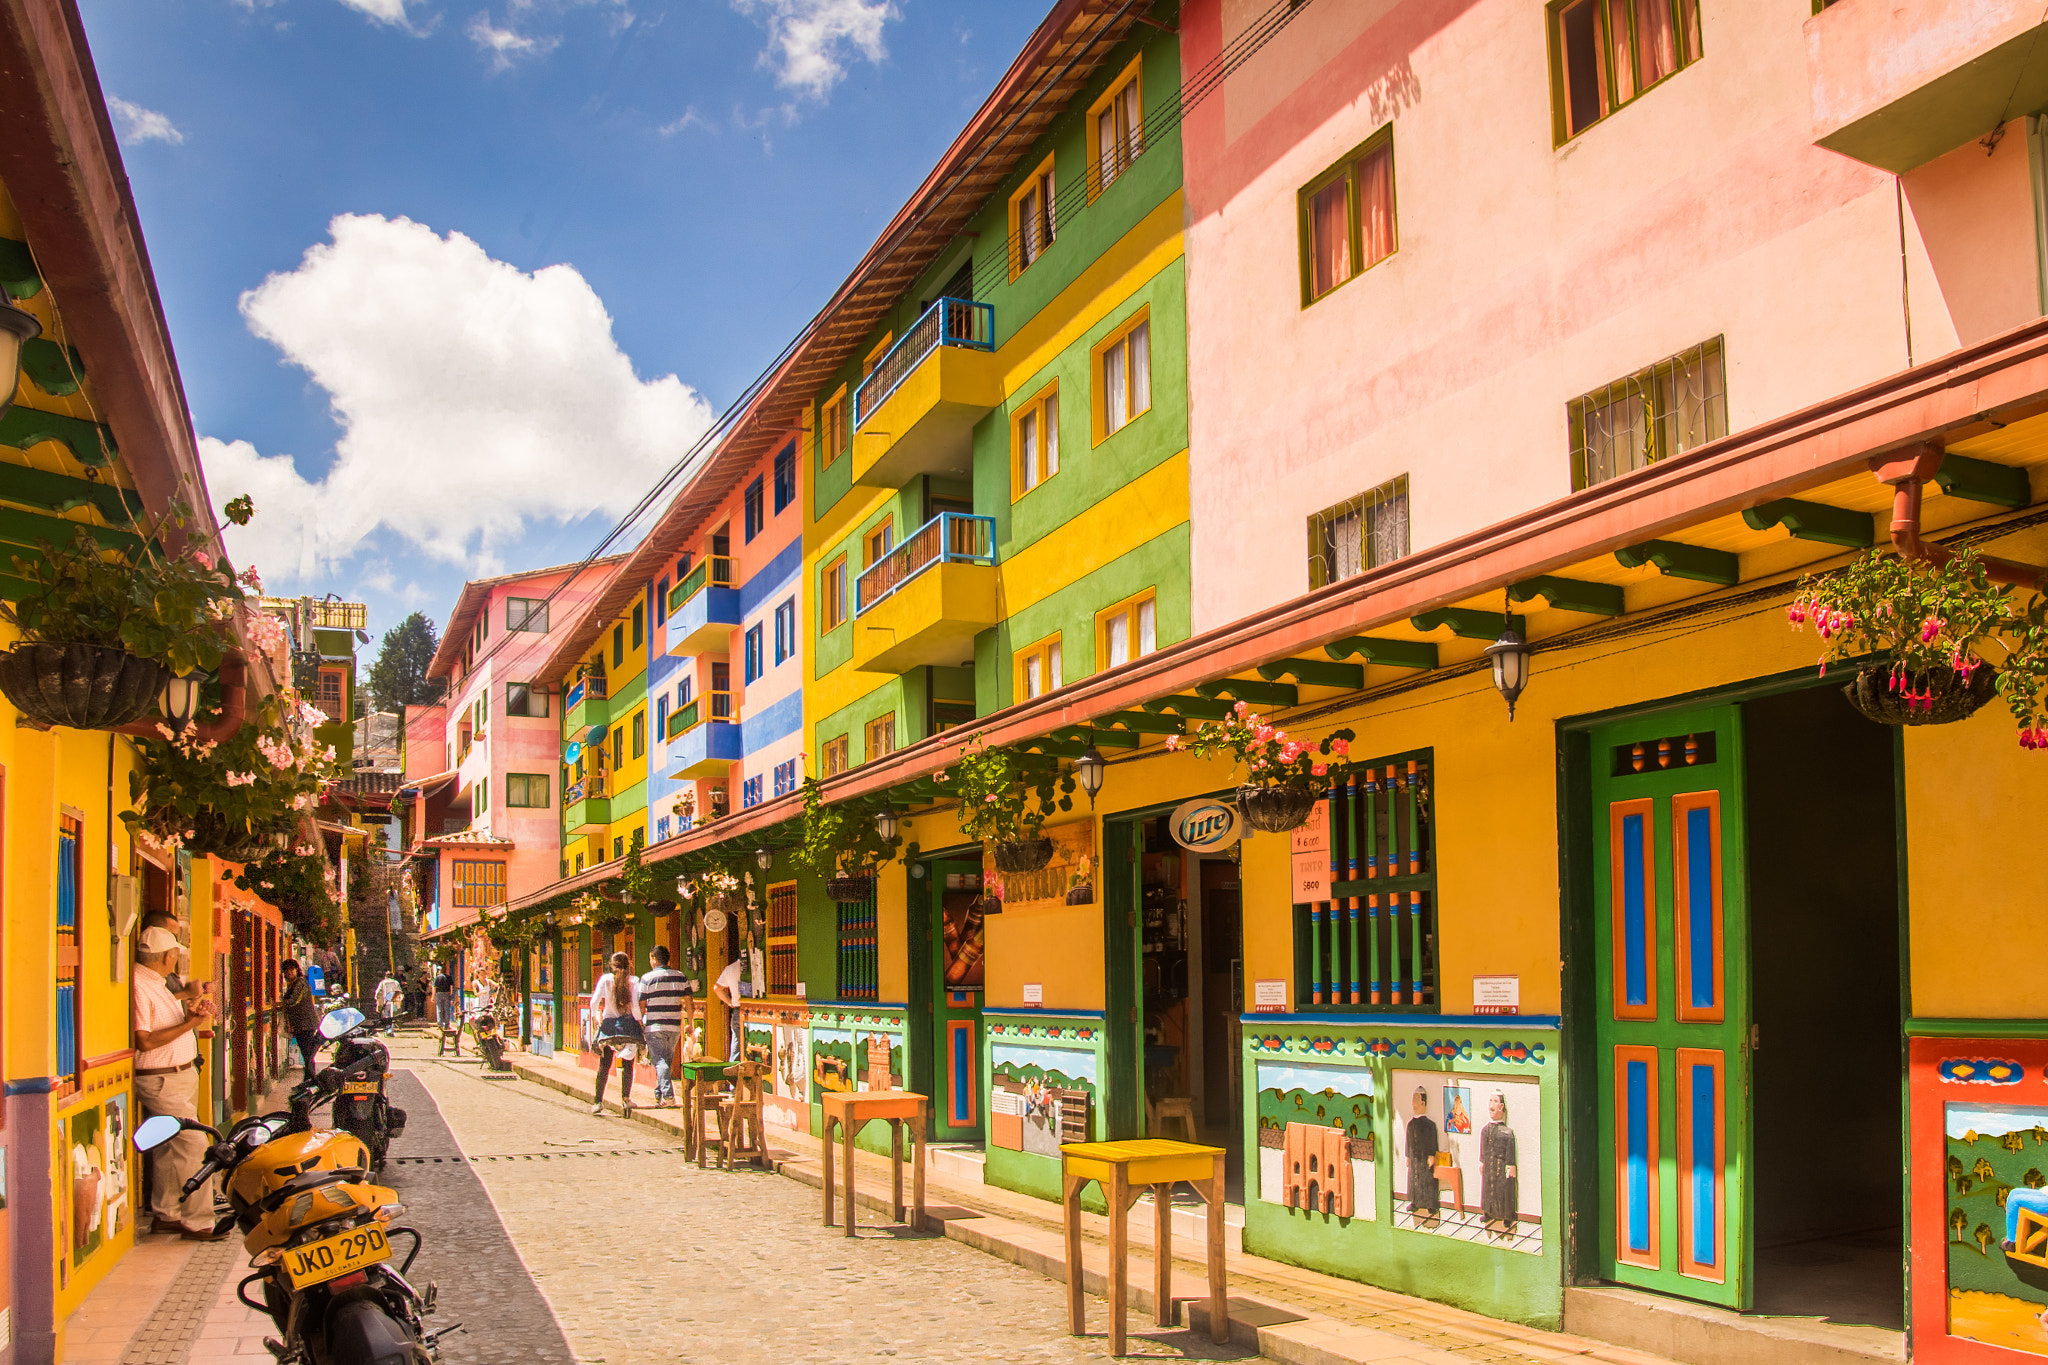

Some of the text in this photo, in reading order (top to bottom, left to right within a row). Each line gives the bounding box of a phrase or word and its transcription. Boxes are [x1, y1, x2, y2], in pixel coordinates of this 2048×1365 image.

[1187, 812, 1226, 846] Lite
[292, 1229, 384, 1277] JKD 29D
